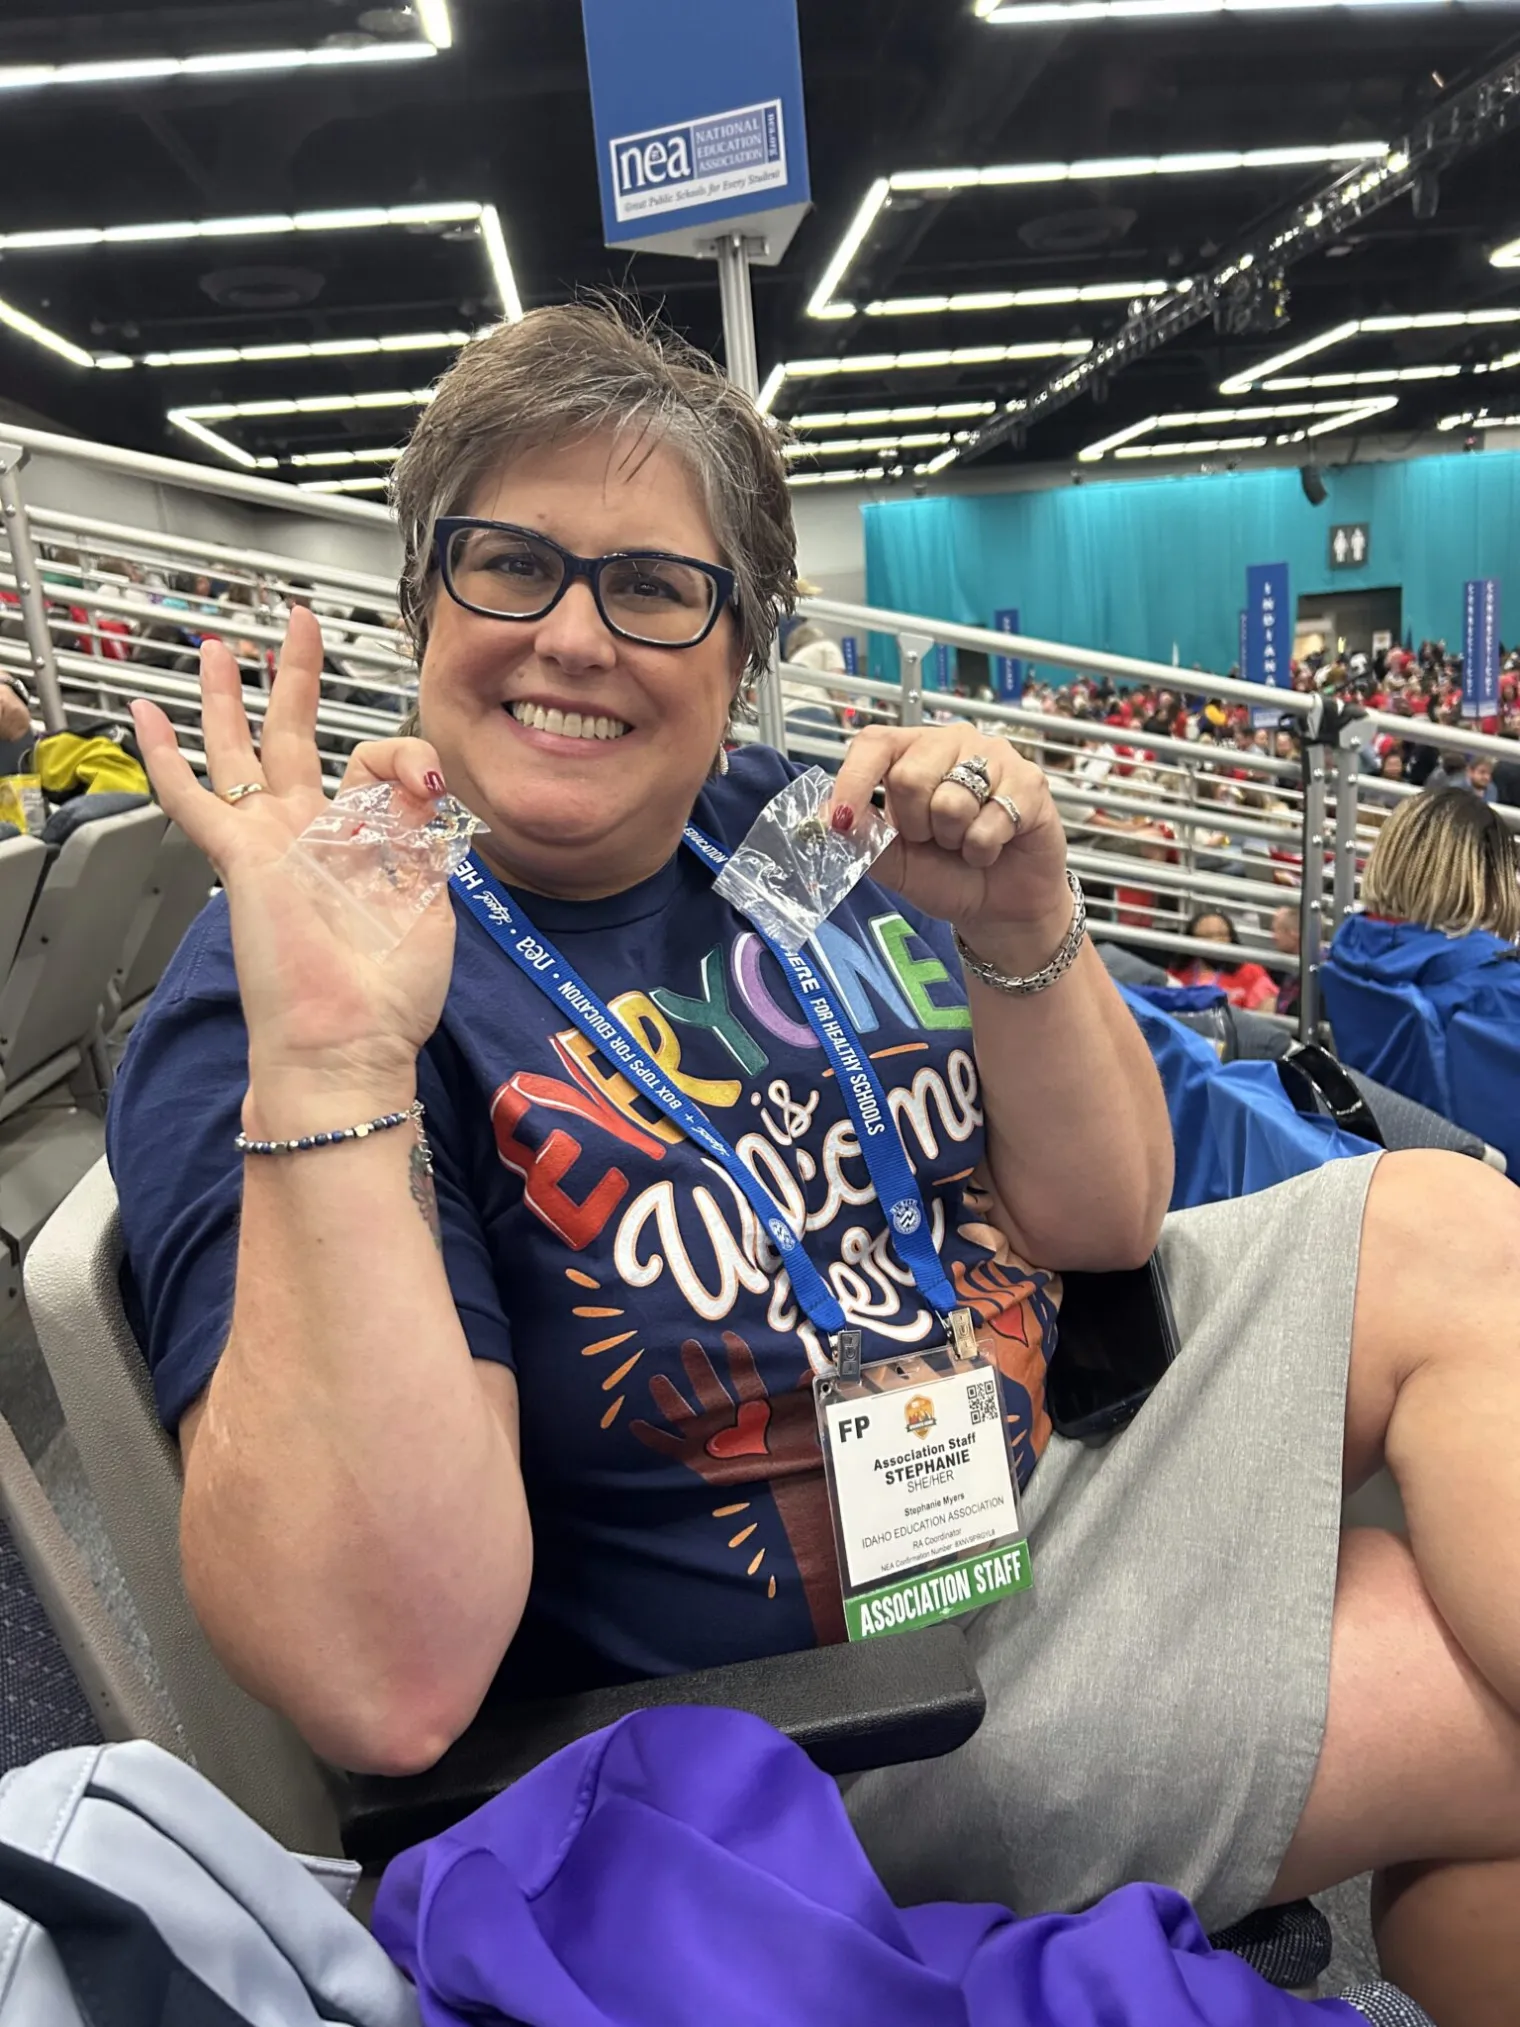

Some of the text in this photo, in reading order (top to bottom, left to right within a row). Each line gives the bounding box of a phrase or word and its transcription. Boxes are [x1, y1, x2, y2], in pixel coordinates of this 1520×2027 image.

[696, 118, 759, 144] NATIONAL
[697, 132, 762, 158] EDUCATION
[620, 136, 691, 190] nea
[699, 148, 763, 171] ASSOCIATION
[648, 193, 673, 207] Public
[675, 185, 707, 200] Schools
[706, 183, 721, 196] for
[722, 178, 747, 191] Every
[1262, 581, 1277, 687] INDIANA
[684, 827, 728, 863] EDUCATION
[472, 890, 512, 925] Lysol
[516, 936, 556, 970] nea
[557, 981, 617, 1040] EDUCATION
[810, 997, 835, 1022] FOR
[609, 1035, 636, 1062] FOR
[821, 1020, 863, 1072] HEALTHY
[630, 1059, 661, 1089] TOPS
[655, 1088, 682, 1110] BOX
[750, 1079, 820, 1146] is
[850, 1074, 885, 1135] SCHOOLS
[838, 1415, 870, 1443] FP
[873, 1432, 976, 1471] Association Staff
[885, 1449, 971, 1485] STEPHANIE
[907, 1469, 954, 1493] SHE/HER
[904, 1492, 965, 1517] Stephanie Myers
[862, 1496, 1005, 1549] IDAHO EDUCATION ASSOCIATION
[912, 1528, 962, 1550] RA Coordinator
[881, 1561, 895, 1572] NEA
[895, 1551, 930, 1567] Confirmation
[860, 1550, 1021, 1637] ASSOCIATION STAFF
